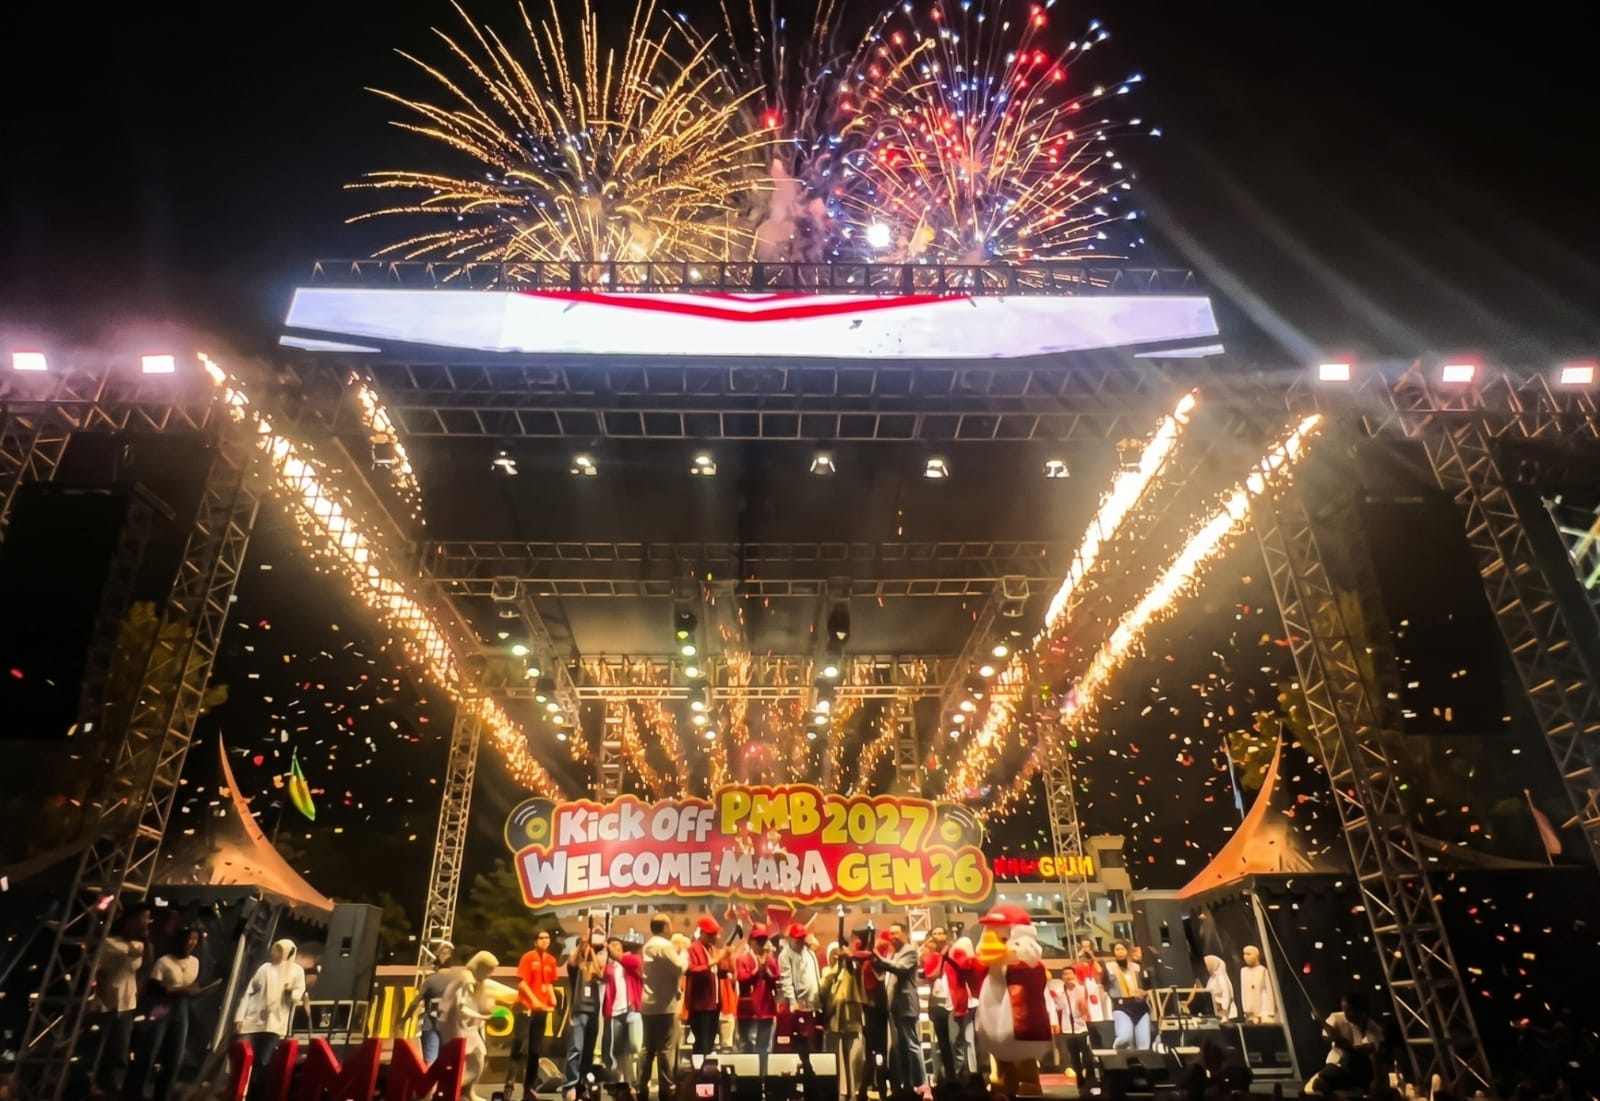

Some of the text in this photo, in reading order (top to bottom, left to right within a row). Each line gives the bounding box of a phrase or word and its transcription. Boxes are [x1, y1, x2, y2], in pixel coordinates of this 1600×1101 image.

[651, 806, 715, 843] OFF
[721, 791, 821, 836] PMB
[821, 802, 930, 852] 2027
[523, 851, 712, 899] WELCOME
[718, 850, 833, 896] MABA
[837, 853, 924, 896] GEN
[929, 853, 984, 894] 26
